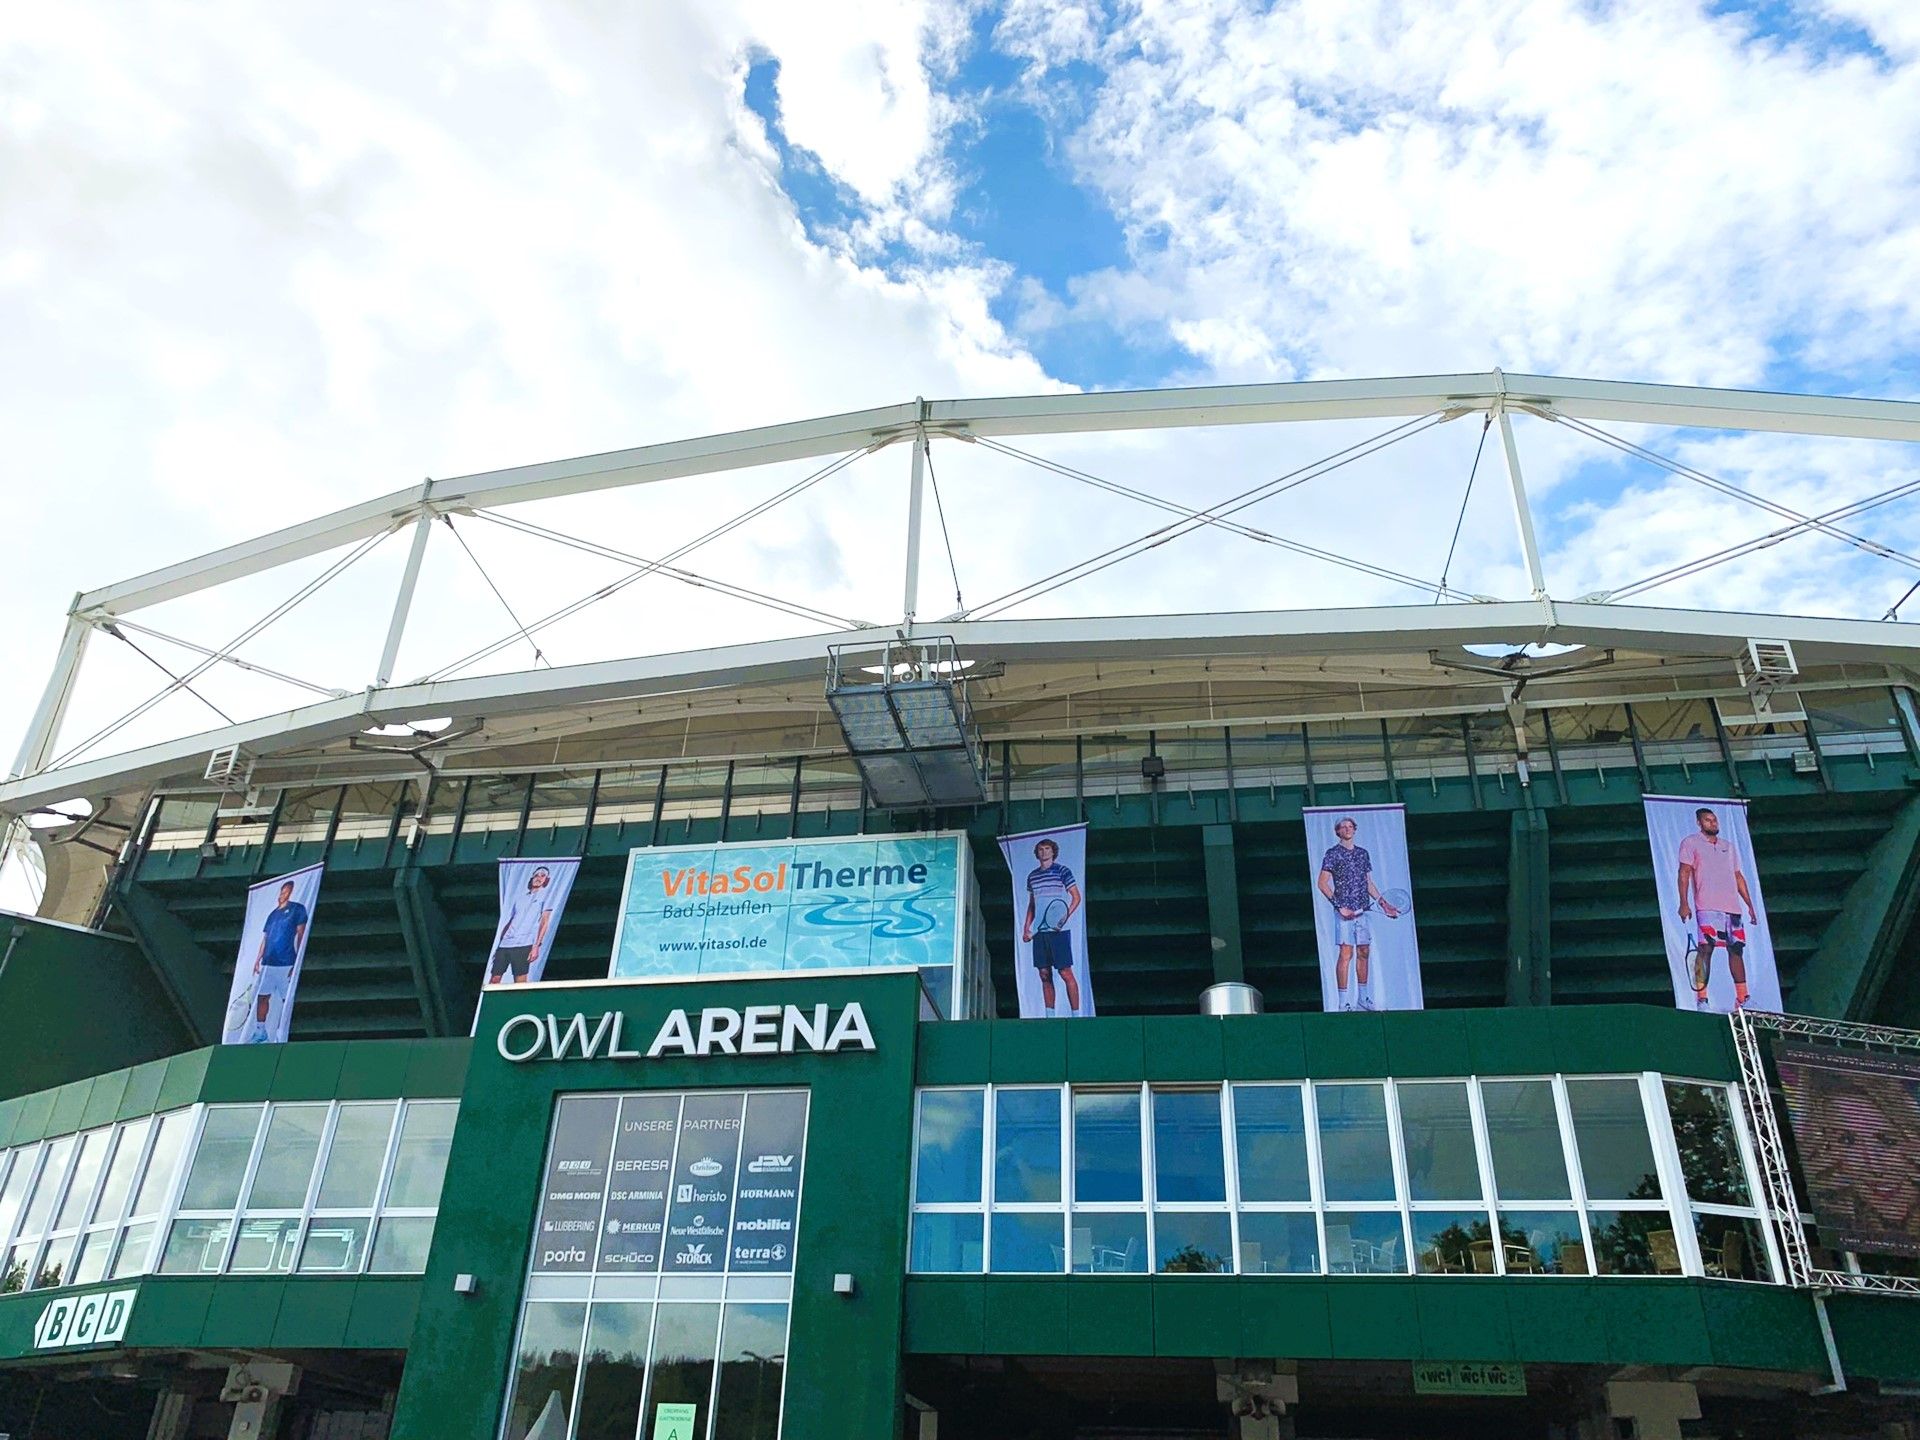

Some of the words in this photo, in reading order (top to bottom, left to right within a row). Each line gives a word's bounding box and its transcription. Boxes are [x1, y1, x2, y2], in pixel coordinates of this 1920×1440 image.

[662, 864, 787, 897] VitaSol
[791, 859, 928, 889] Therme
[663, 903, 693, 919] Bad
[699, 900, 772, 917] Salzuflen
[658, 936, 768, 953] www.vitasol.de
[497, 1011, 641, 1062] OWL
[646, 1002, 877, 1058] ARENA
[624, 1120, 673, 1132] UNSERE
[683, 1118, 740, 1131] PARTNER
[615, 1160, 669, 1171] BERESA
[549, 1192, 574, 1200] DMG
[574, 1192, 601, 1200] MORI
[611, 1191, 629, 1200] DSC
[628, 1191, 664, 1200] ARMINIA
[692, 1188, 727, 1202] heristo
[621, 1223, 661, 1231] MERKUR
[670, 1226, 685, 1235] Neue
[736, 1219, 791, 1230] nobilia
[544, 1246, 586, 1266] porta
[675, 1252, 712, 1264] STORCK
[735, 1246, 770, 1259] terra
[47, 1306, 67, 1340] B
[77, 1302, 96, 1338] C
[104, 1299, 125, 1335] D
[1426, 1371, 1445, 1383] WC
[1460, 1372, 1479, 1384] WC
[1488, 1373, 1507, 1385] WC
